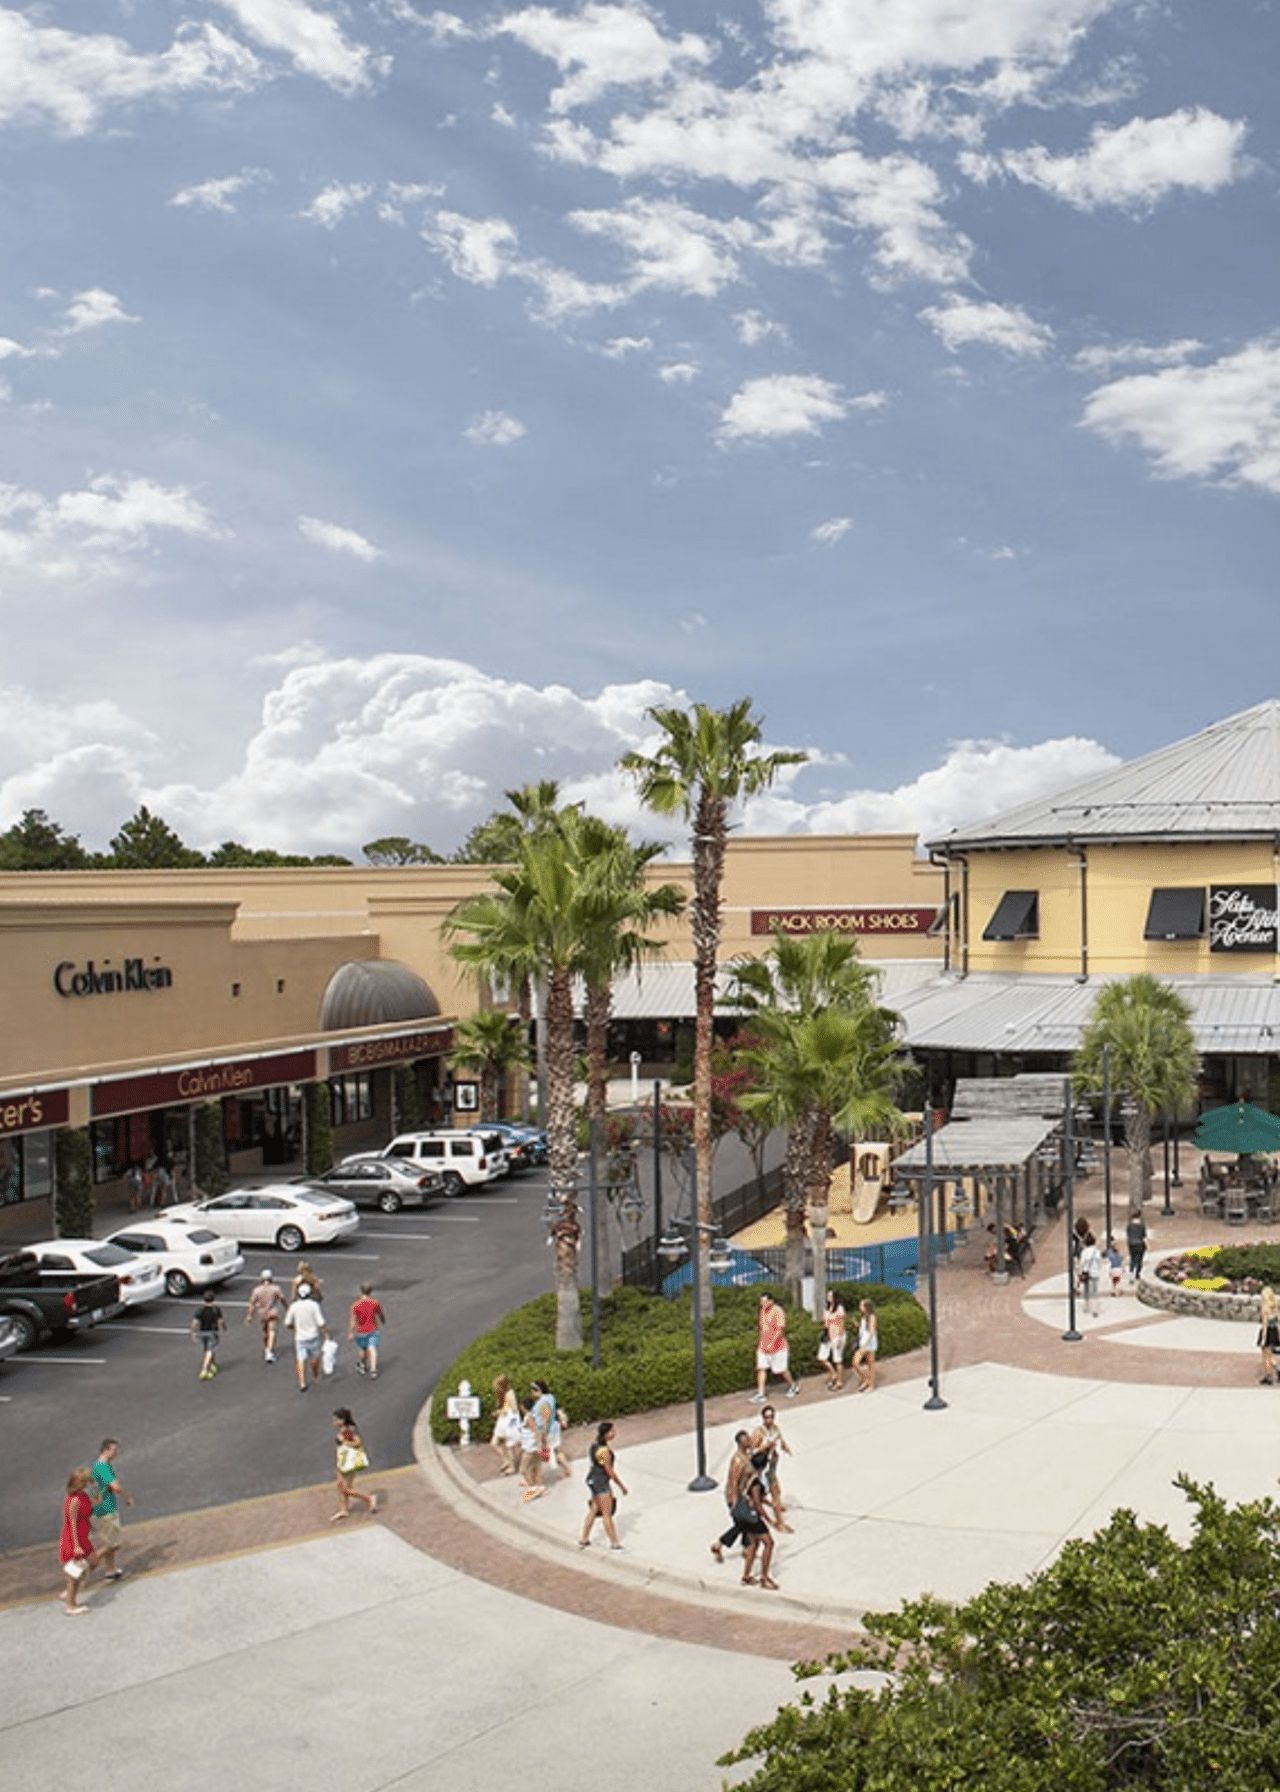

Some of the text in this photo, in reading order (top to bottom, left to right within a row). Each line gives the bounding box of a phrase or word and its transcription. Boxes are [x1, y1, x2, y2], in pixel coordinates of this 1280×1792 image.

[815, 913, 865, 930] ROOM
[868, 912, 919, 930] SHOES
[0, 1095, 43, 1129] er's
